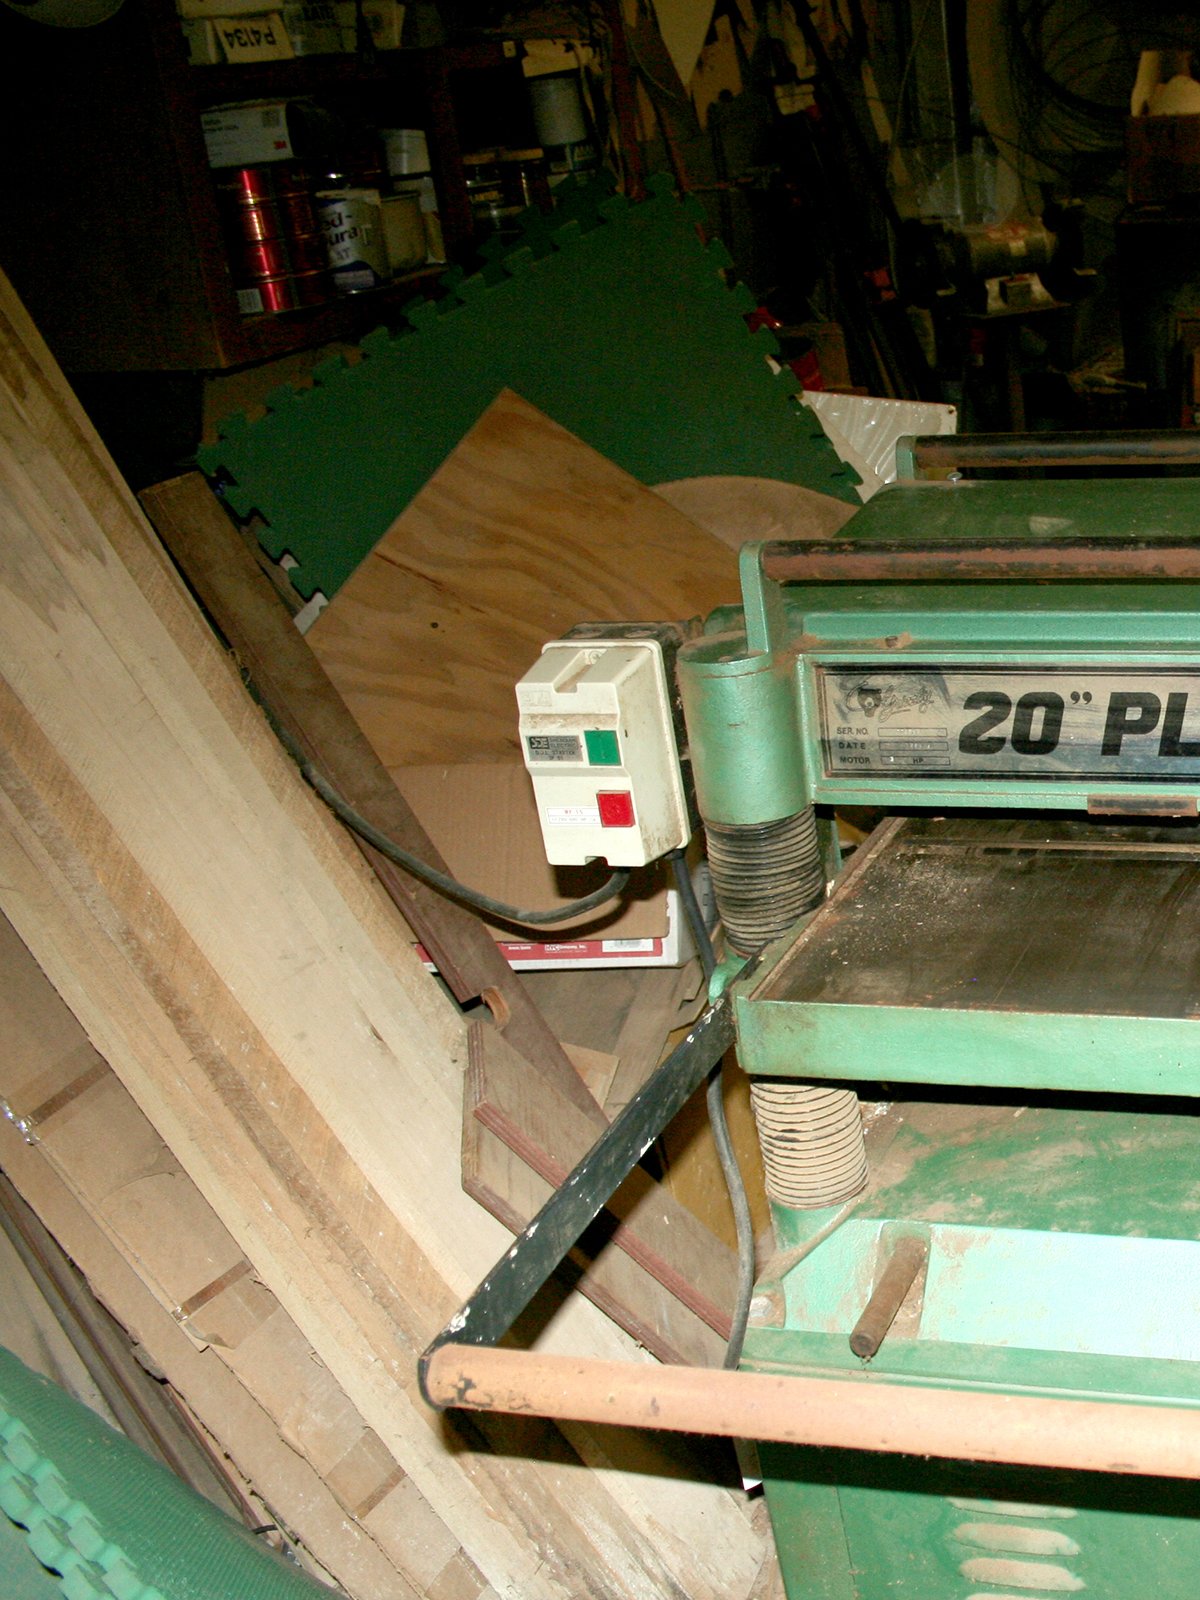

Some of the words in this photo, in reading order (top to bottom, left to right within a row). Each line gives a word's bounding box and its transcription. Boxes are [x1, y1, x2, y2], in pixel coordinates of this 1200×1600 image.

[223, 25, 277, 49] P4134
[838, 742, 866, 750] DATE
[839, 756, 872, 765] MOTOR
